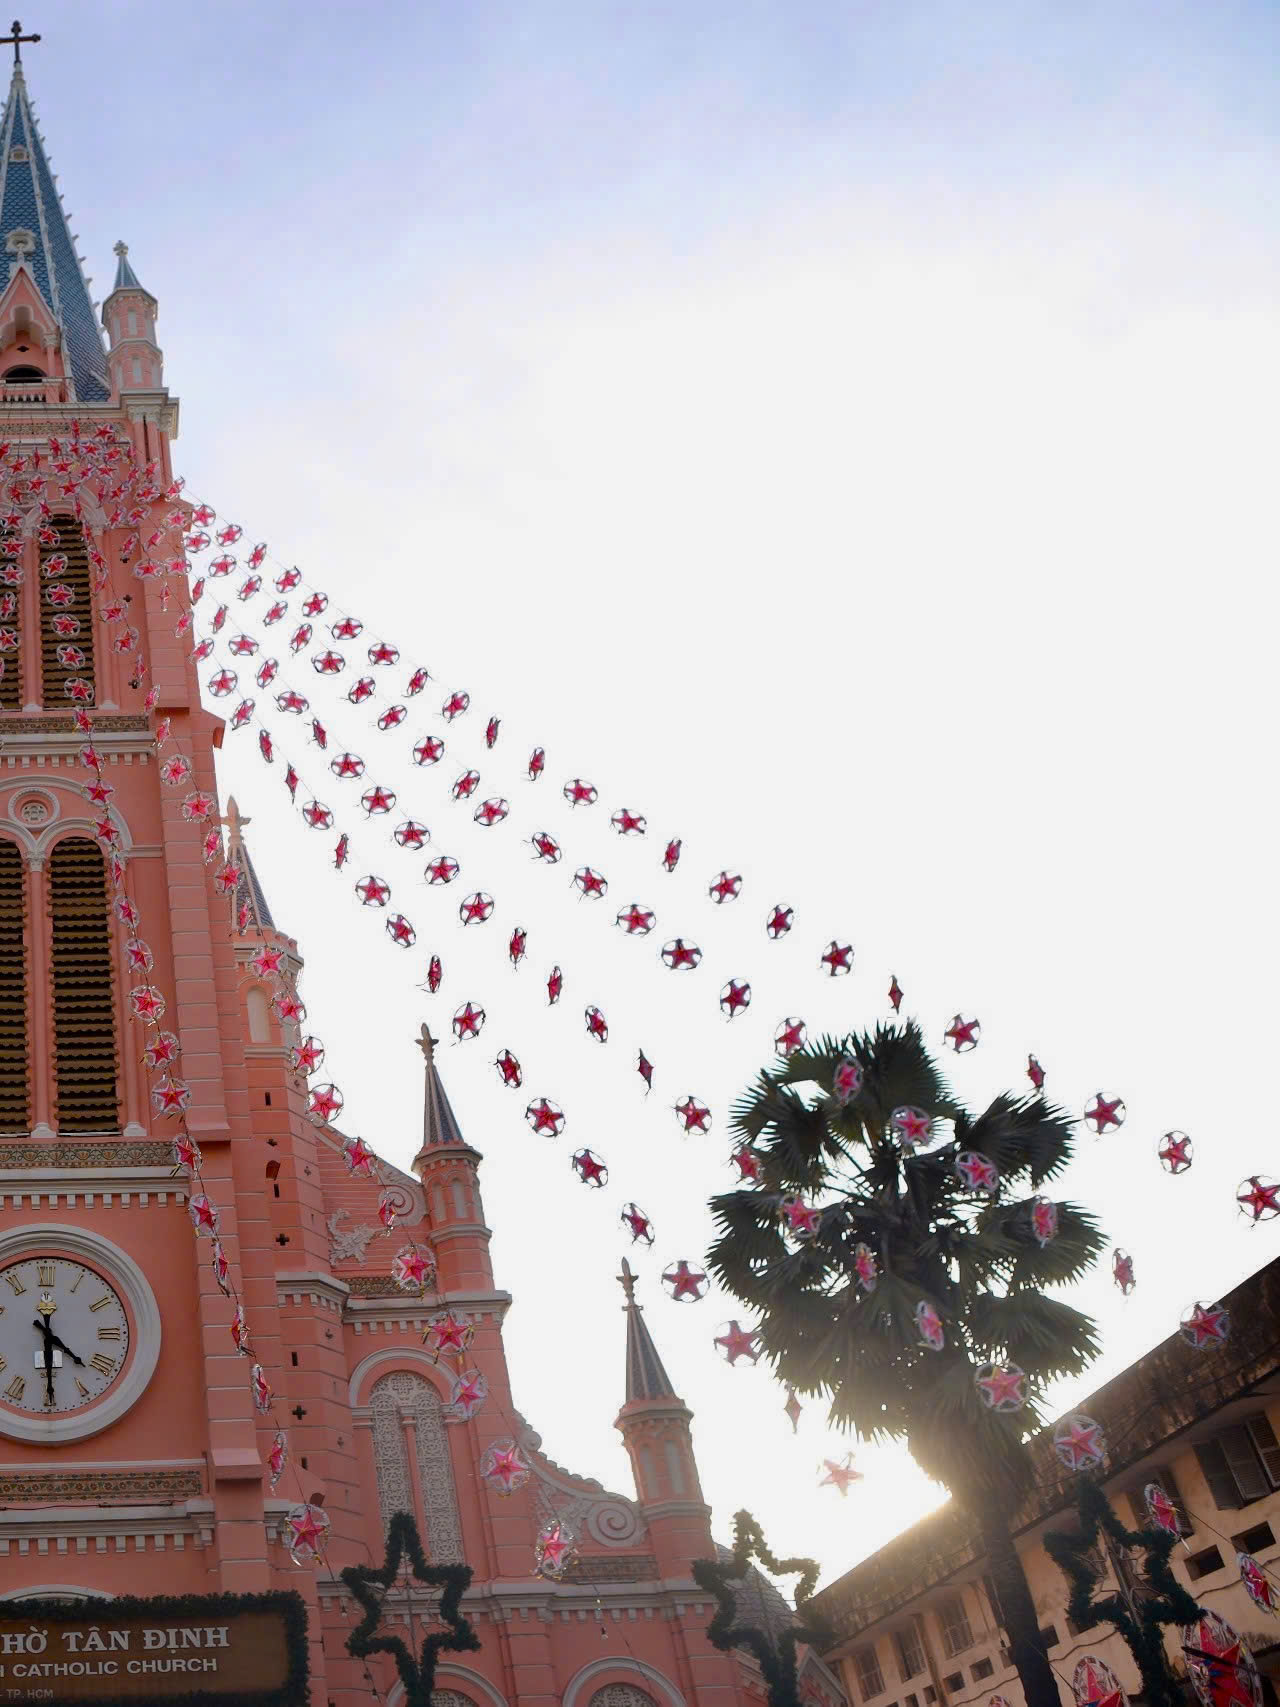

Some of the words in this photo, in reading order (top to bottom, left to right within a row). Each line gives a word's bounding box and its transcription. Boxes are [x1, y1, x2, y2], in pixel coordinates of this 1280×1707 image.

[36, 1266, 55, 1287] XII
[98, 1327, 121, 1341] III
[61, 1625, 131, 1652] TÂN
[142, 1626, 231, 1654] ĐỊNH
[12, 1661, 119, 1678] CATHOLIC
[126, 1658, 218, 1674] CHURCH
[27, 1688, 54, 1700] HCM
